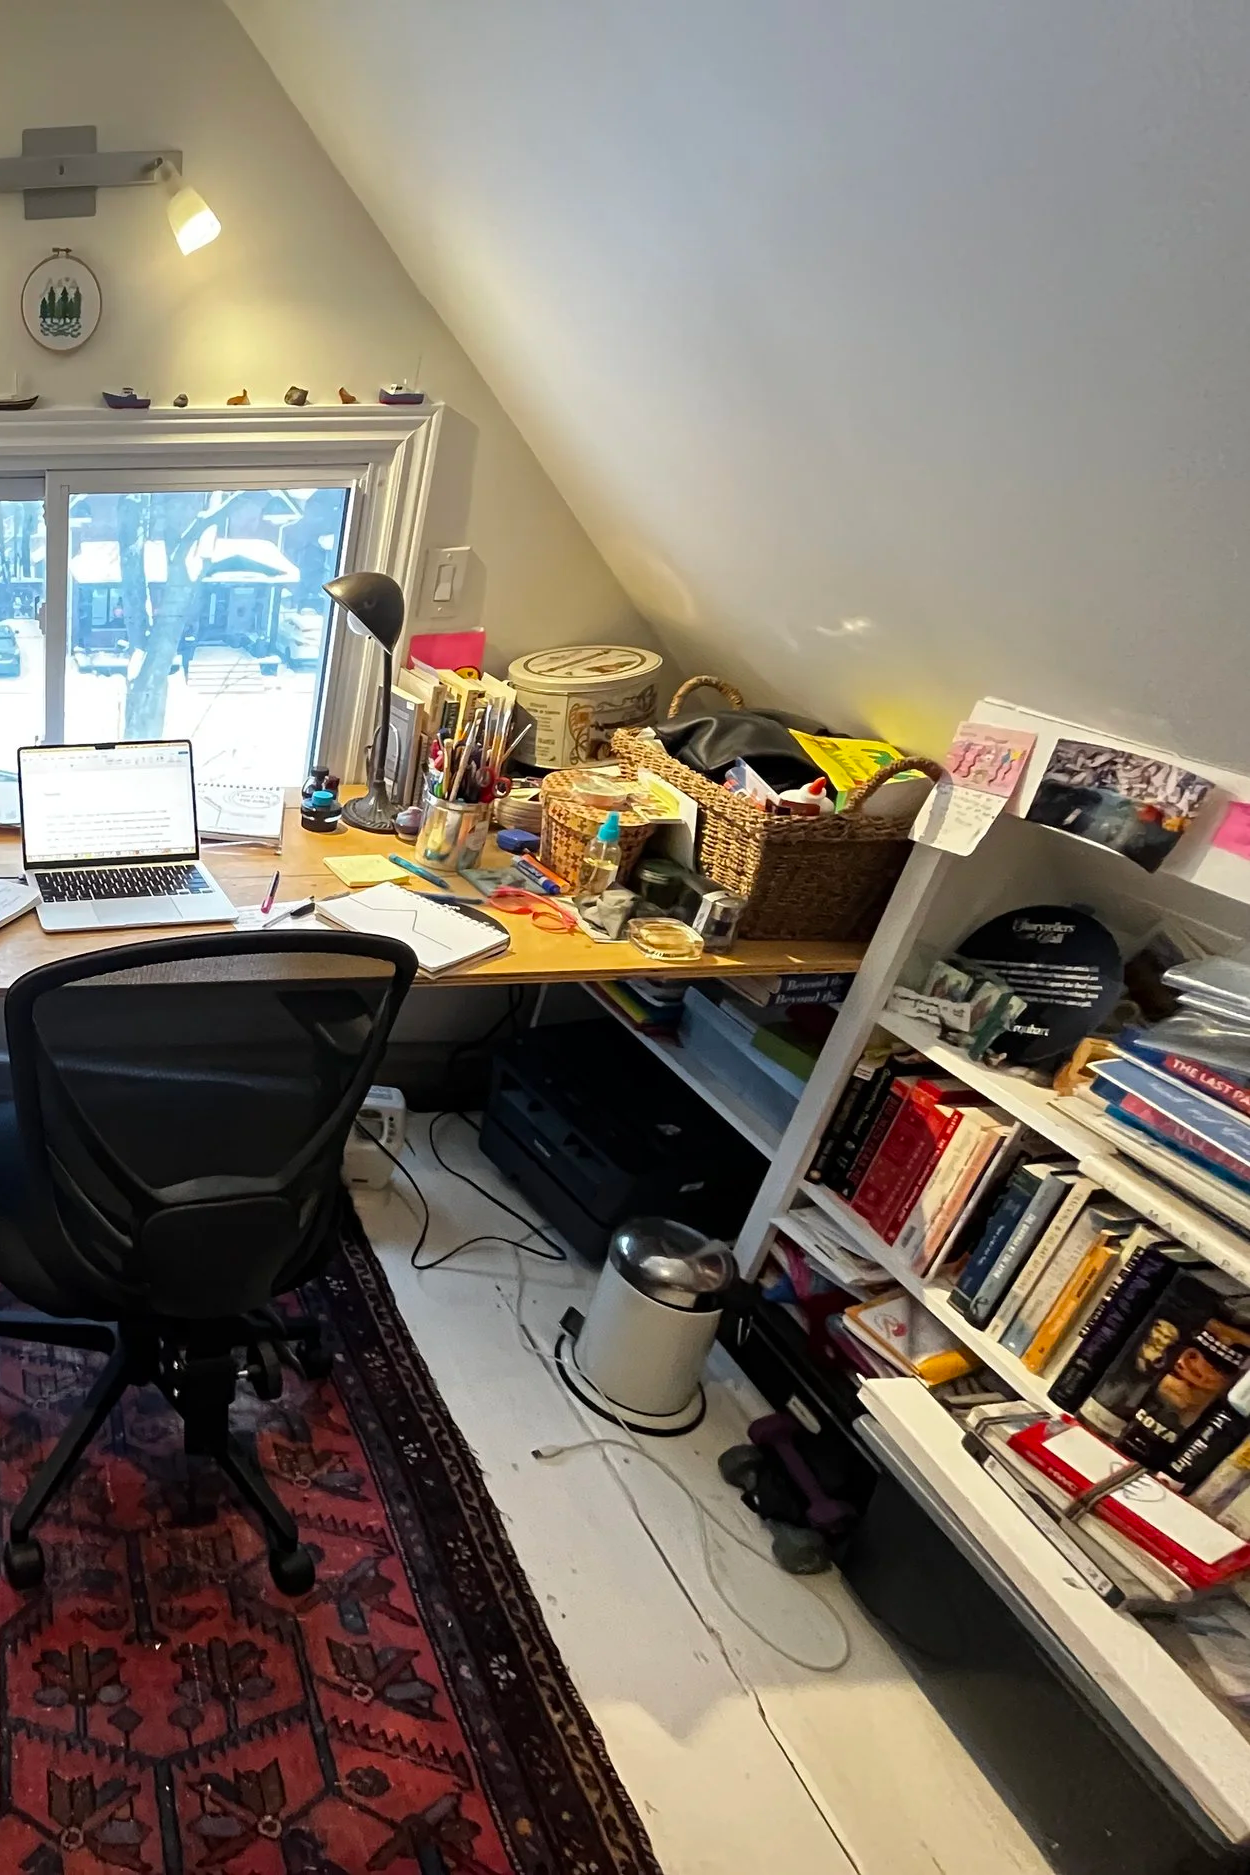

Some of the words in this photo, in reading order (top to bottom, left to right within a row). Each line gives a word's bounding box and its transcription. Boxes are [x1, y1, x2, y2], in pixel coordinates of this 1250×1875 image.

[787, 977, 828, 991] Beyond
[776, 993, 820, 1003] Beyond
[822, 991, 838, 1001] the
[1172, 1058, 1199, 1078] THE
[1202, 1071, 1234, 1095] LAST
[1135, 1407, 1179, 1444] GOYA
